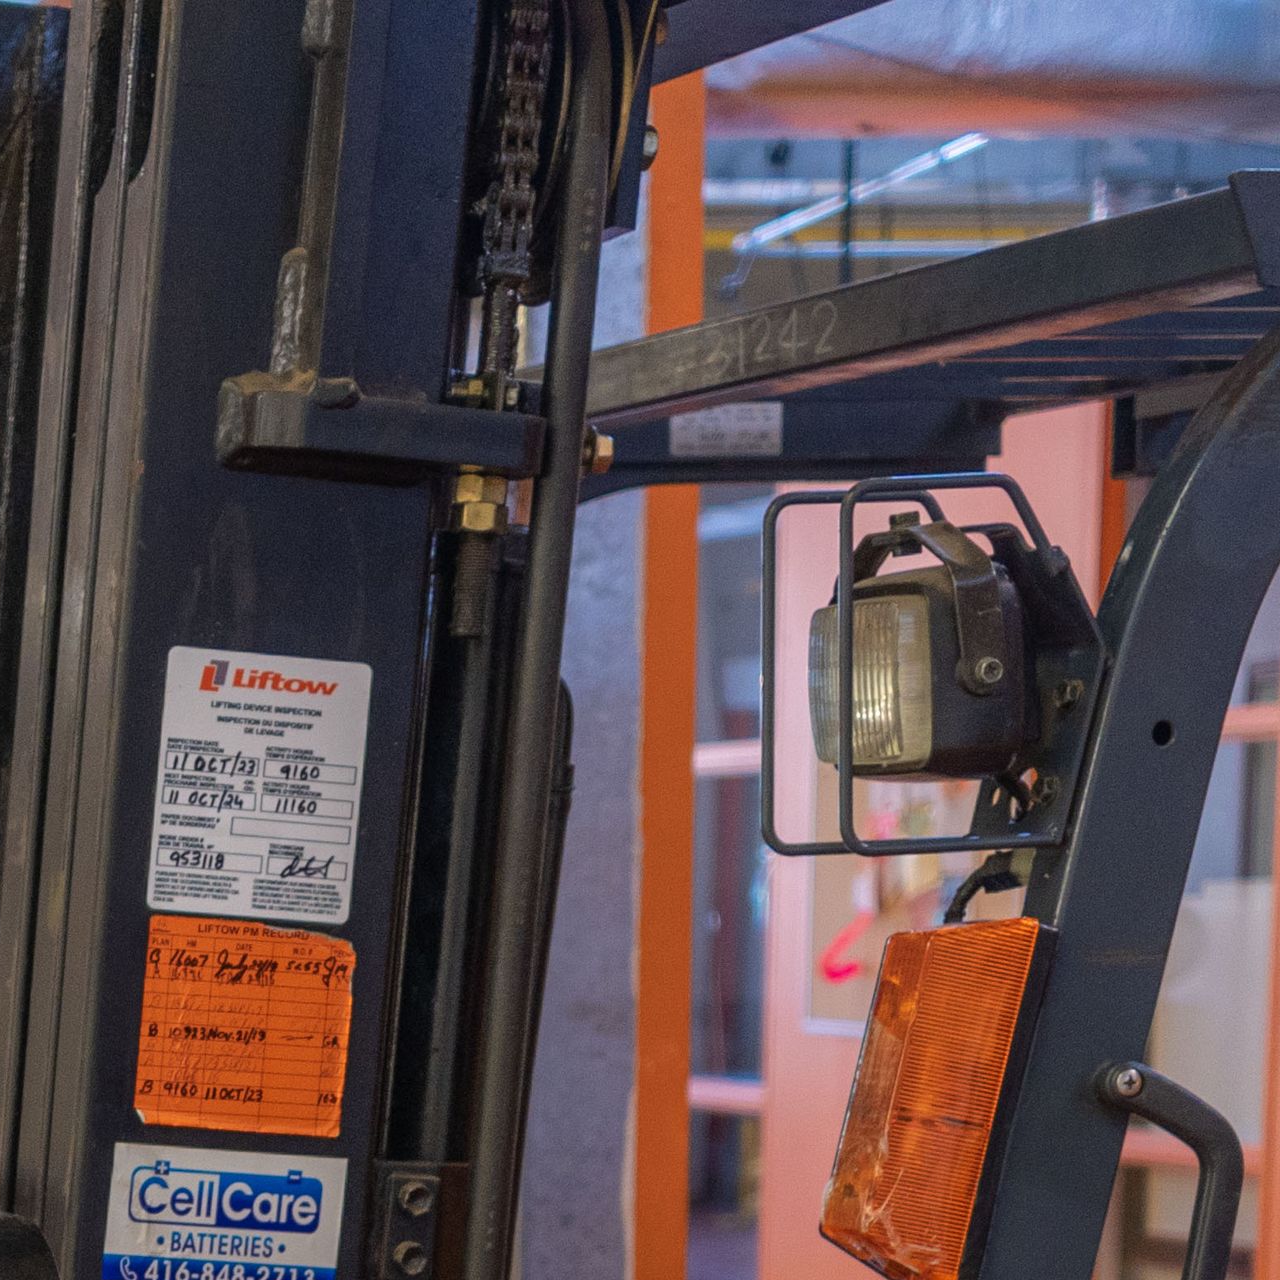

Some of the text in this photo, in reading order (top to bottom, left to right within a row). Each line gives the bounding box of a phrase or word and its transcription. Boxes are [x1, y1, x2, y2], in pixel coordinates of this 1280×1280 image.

[232, 668, 338, 696] Liftow
[211, 701, 322, 717] LIFTING DEVICE INSPECTION
[217, 716, 314, 730] INSPECTION DU DISPOSITIF
[256, 729, 285, 737] LEVAGE
[167, 738, 203, 746] INSPECTION
[194, 751, 256, 776] OCT/23
[280, 764, 320, 782] 9160
[168, 789, 243, 812] 11 OCT/24
[170, 851, 225, 870] 953118
[198, 924, 310, 941] LIFTOW PM RECORD
[152, 938, 170, 947] PLAN
[235, 943, 253, 951] DATE
[148, 1023, 159, 1037] B
[139, 1079, 153, 1094] B
[163, 1080, 198, 1097] 9160
[138, 1175, 318, 1226] CellCare
[170, 1231, 274, 1258] BATTERIES
